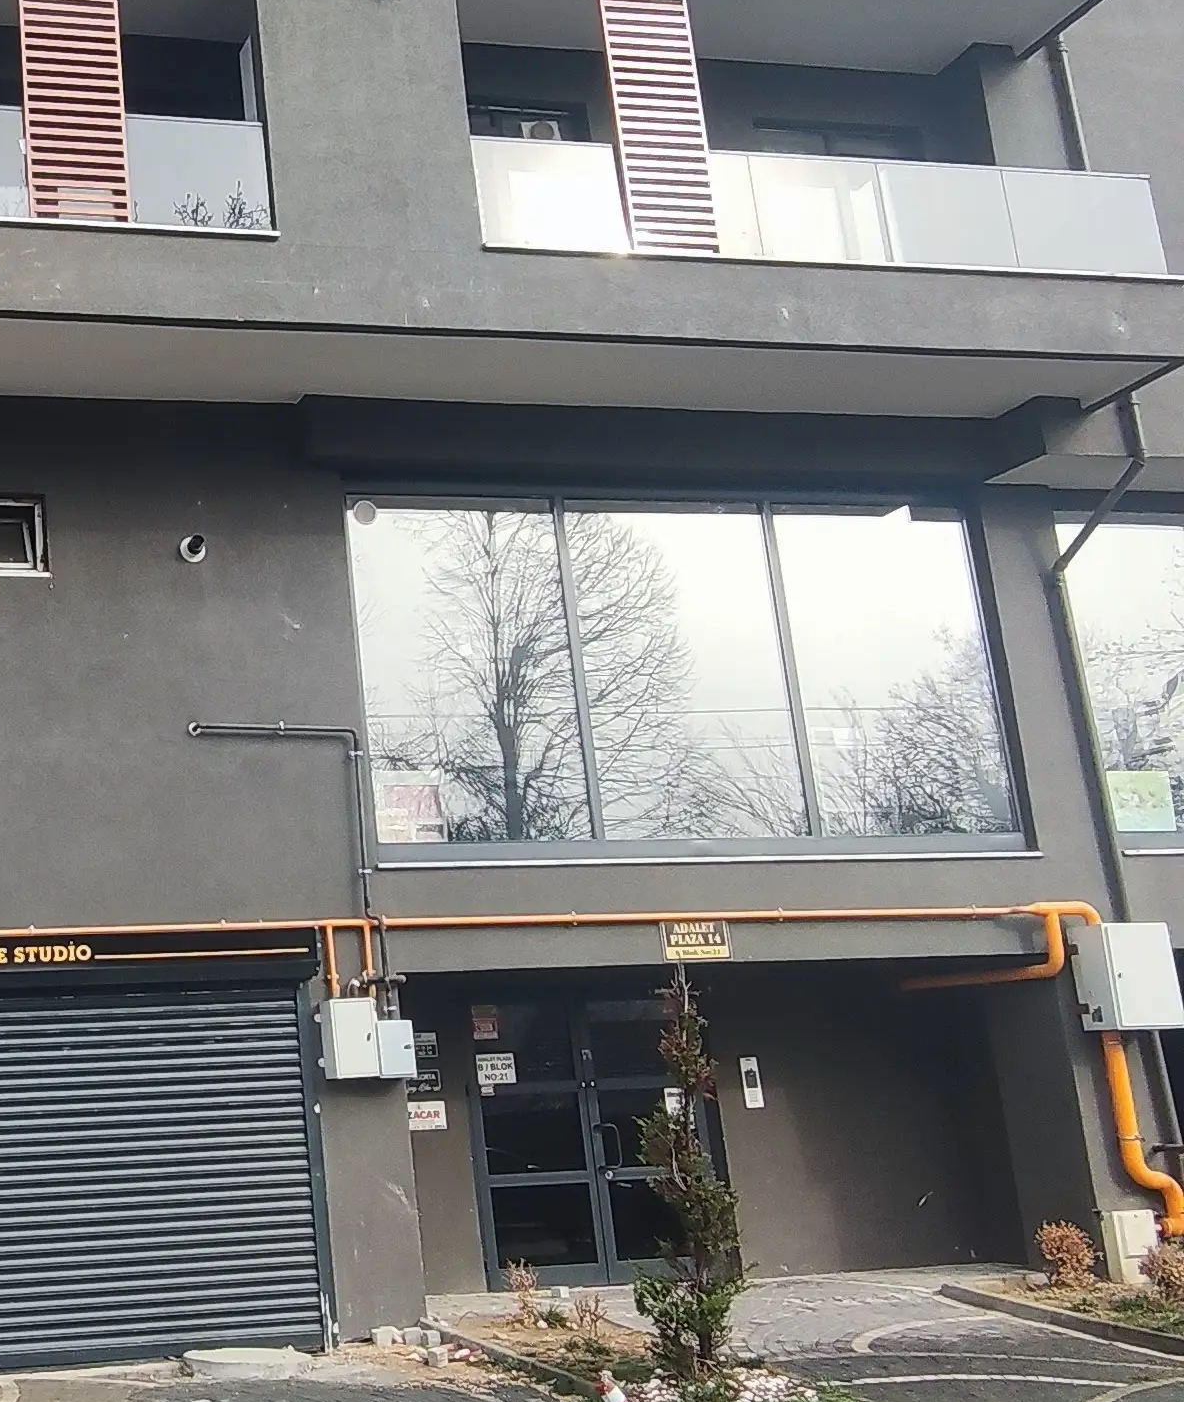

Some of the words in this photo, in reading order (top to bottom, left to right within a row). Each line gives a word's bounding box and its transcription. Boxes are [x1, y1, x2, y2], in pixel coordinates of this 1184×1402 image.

[673, 922, 715, 933] ADALET
[670, 933, 705, 945] PLAZA
[708, 933, 722, 944] 14
[490, 1062, 513, 1071] BLOK
